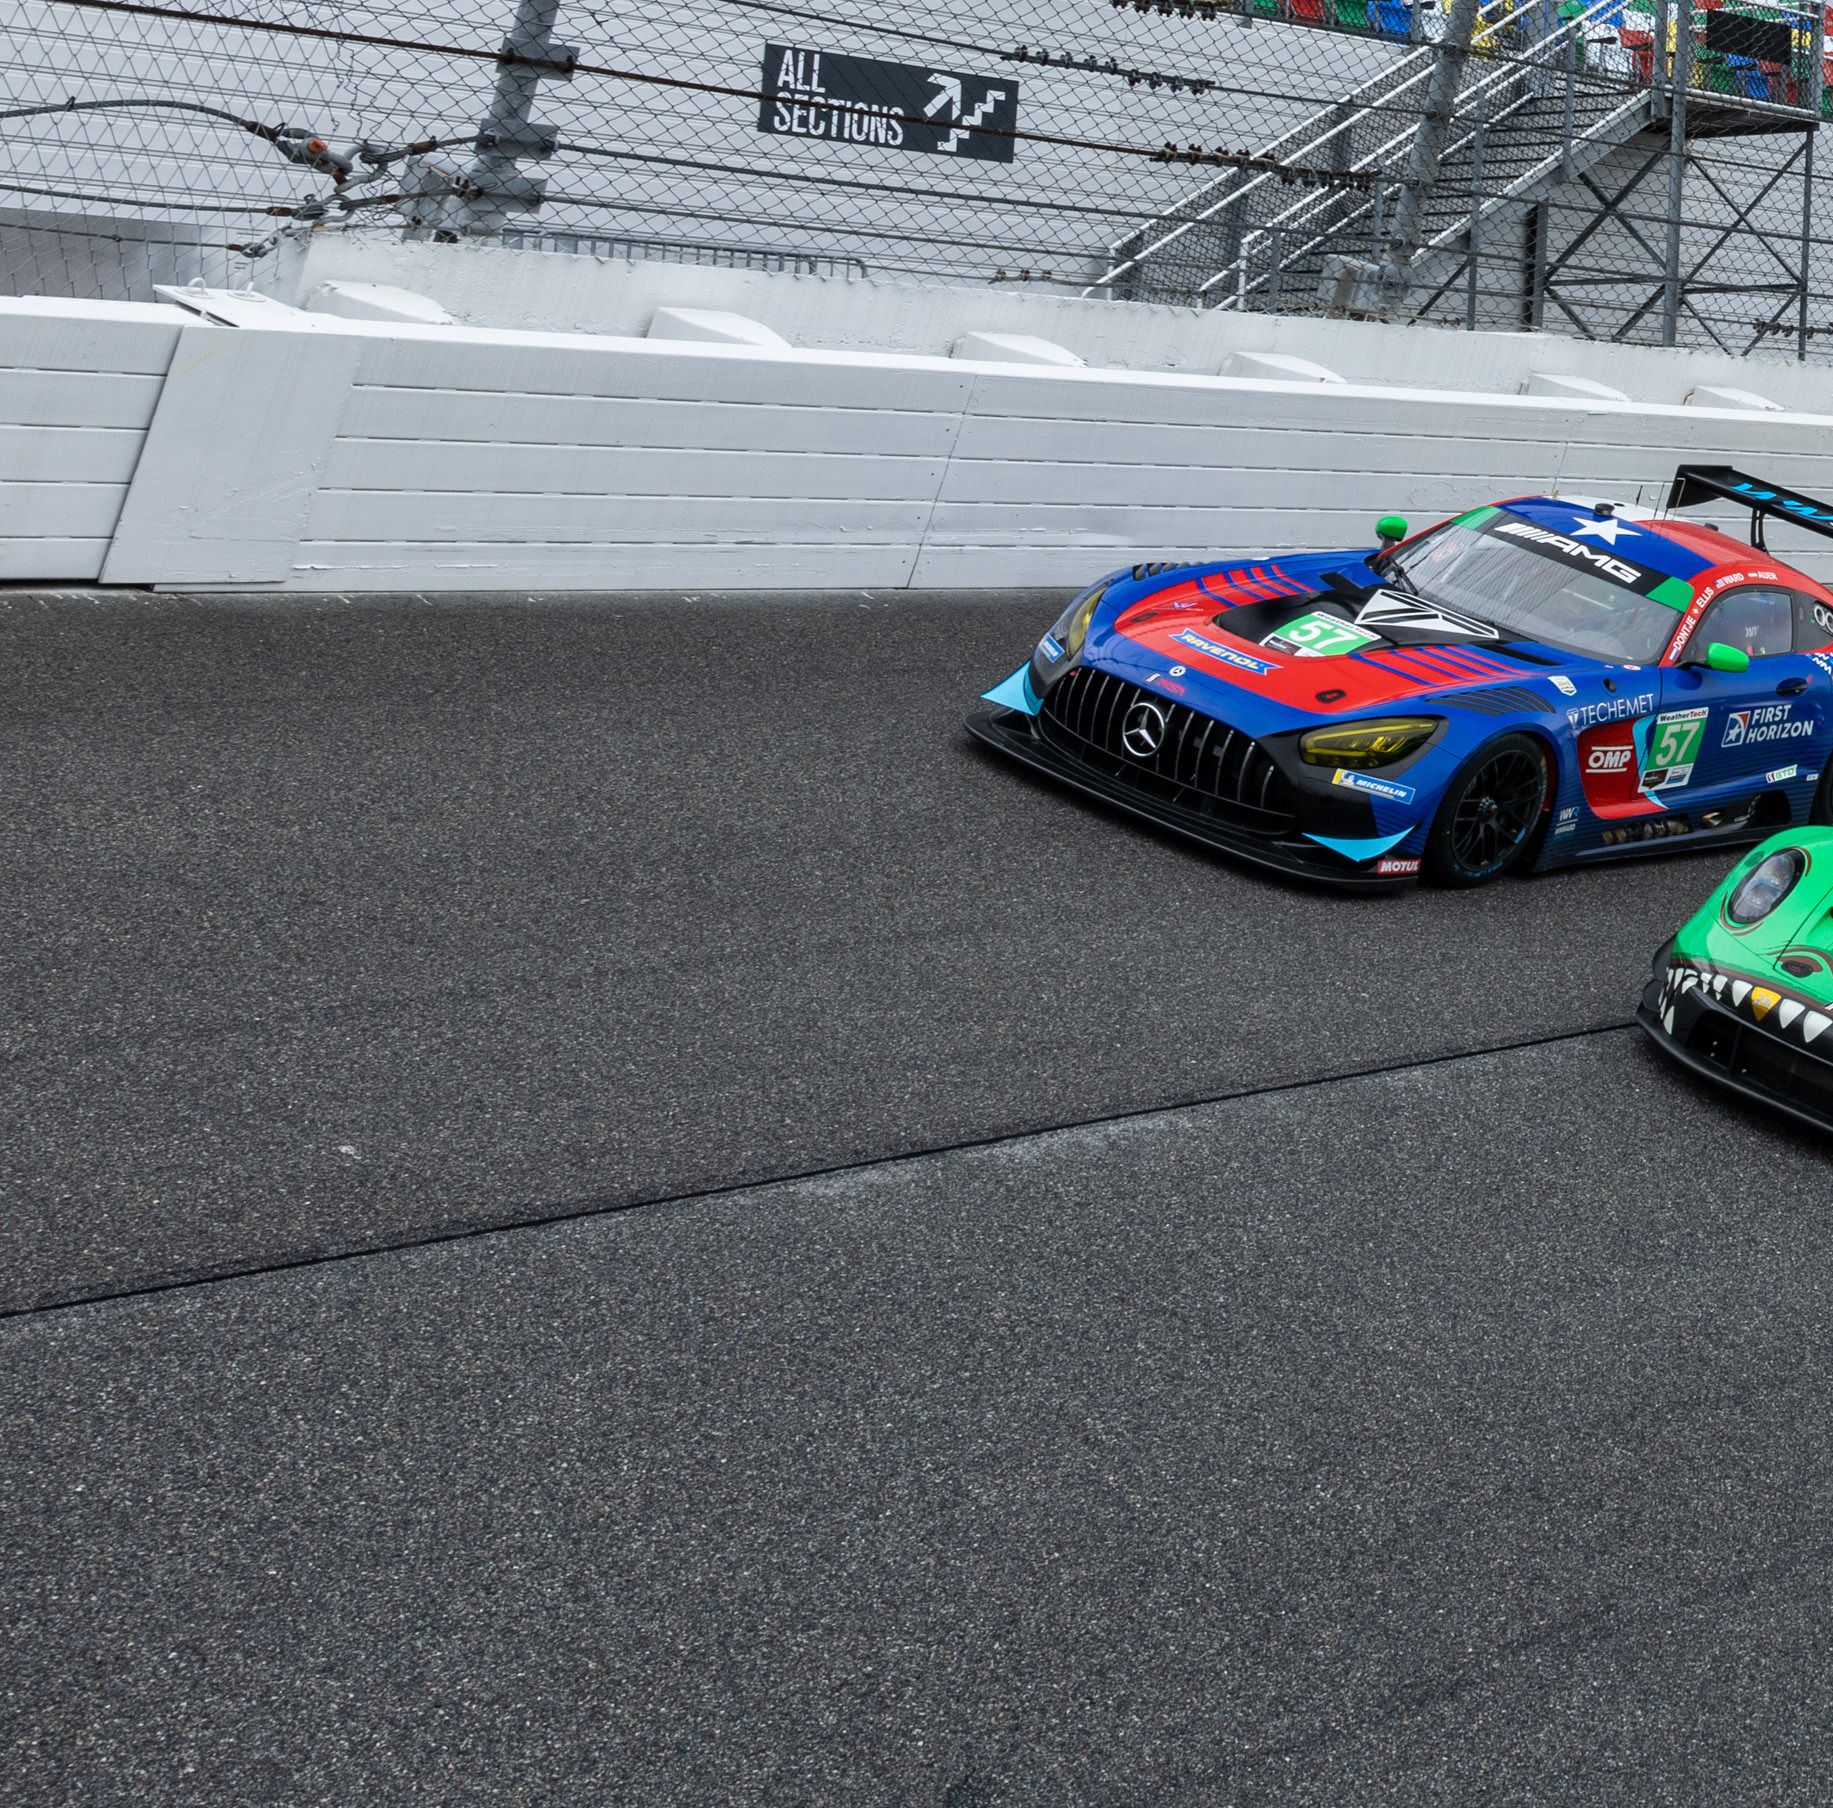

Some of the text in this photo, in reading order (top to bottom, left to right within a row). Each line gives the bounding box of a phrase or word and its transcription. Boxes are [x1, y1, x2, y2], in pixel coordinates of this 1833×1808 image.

[777, 49, 825, 94] ALL
[773, 92, 904, 146] SECTIONS
[1540, 533, 1642, 584] AMG
[1722, 572, 1744, 587] WARD
[1696, 587, 1714, 609] ELLIS
[1289, 619, 1360, 650] 57
[1673, 616, 1697, 651] DONTJE
[1182, 633, 1261, 669] RAVENOL
[1580, 693, 1654, 725] TECHEMET
[1660, 709, 1707, 722] WeatherTech
[1751, 704, 1791, 725] FIRST
[1745, 721, 1814, 743] HORIZON
[1655, 722, 1701, 766] 57
[1588, 751, 1631, 768] OMP
[1775, 768, 1795, 780] GTD
[1356, 779, 1408, 798] MICHELIN
[1380, 861, 1419, 873] MOTUL
